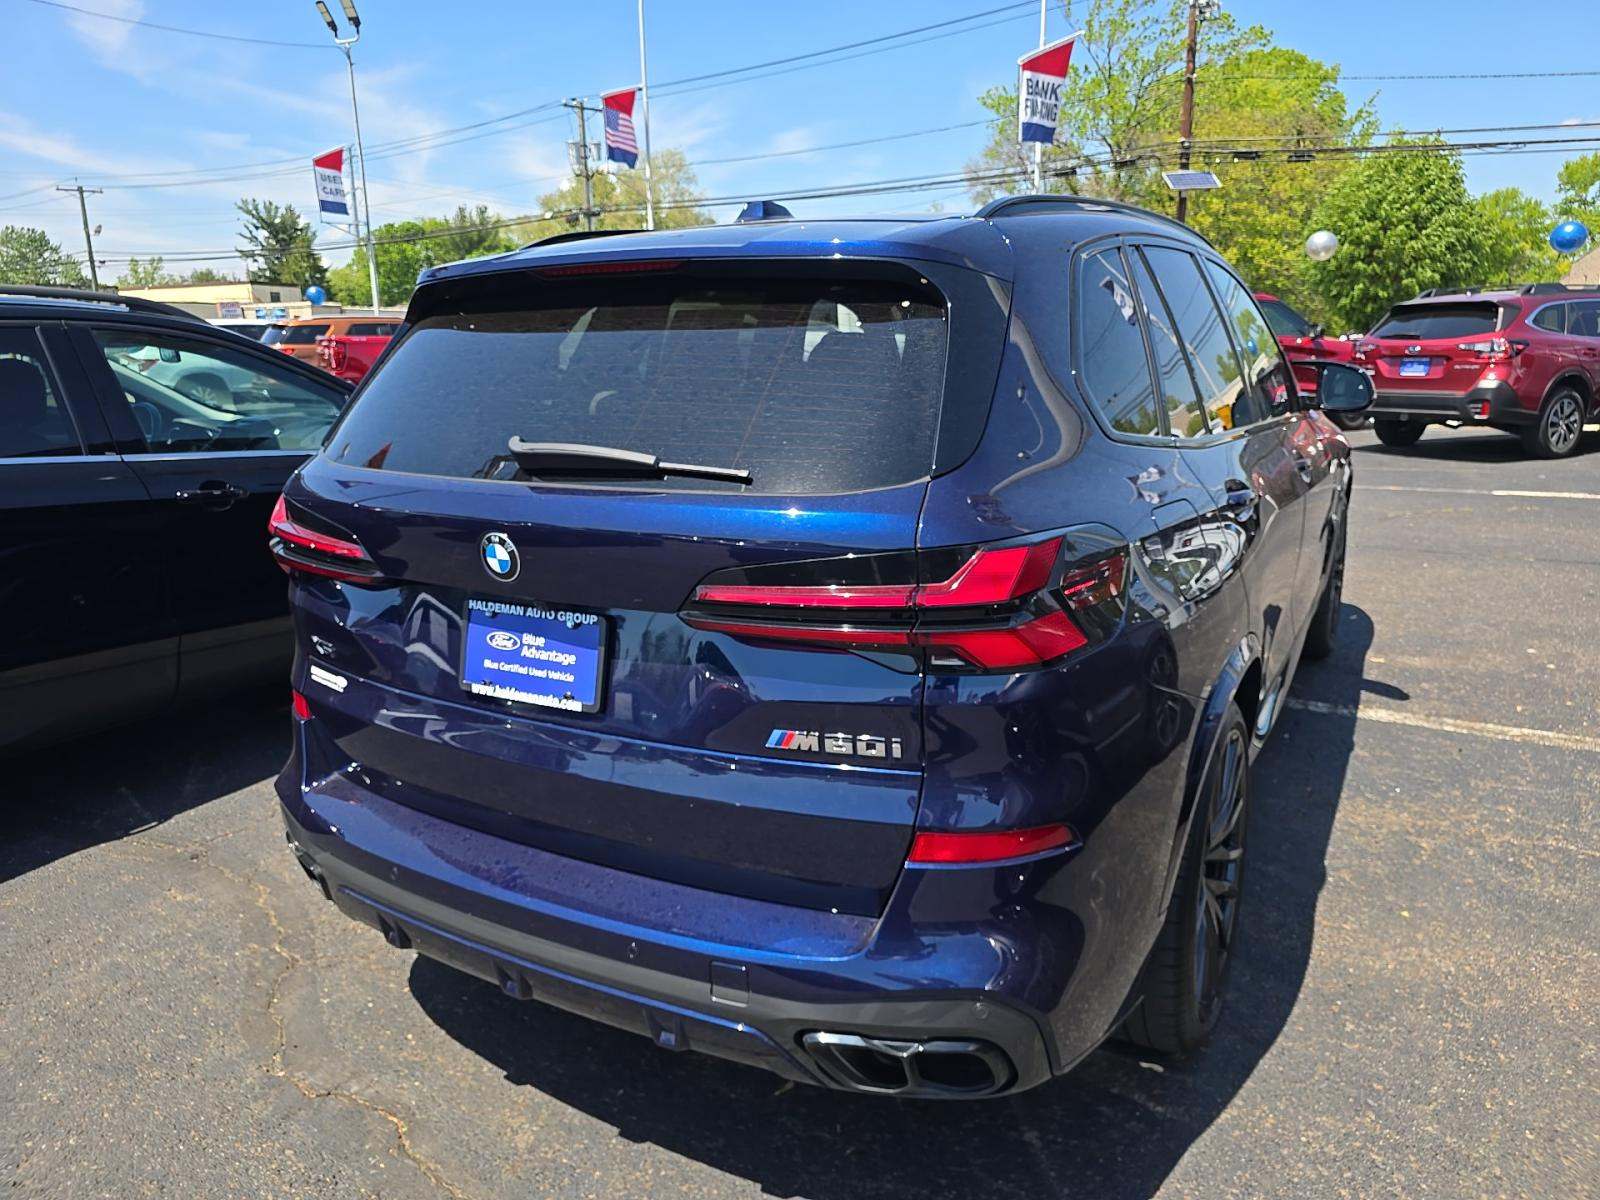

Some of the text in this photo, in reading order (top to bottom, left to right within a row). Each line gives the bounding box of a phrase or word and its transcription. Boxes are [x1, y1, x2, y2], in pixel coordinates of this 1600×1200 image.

[1026, 78, 1062, 102] BANK
[468, 599, 599, 626] HALDEMAN AUTO GROUP
[522, 633, 546, 647] Blue
[521, 646, 577, 666] Advantage
[483, 659, 575, 683] Blue Certified Used Vehicle
